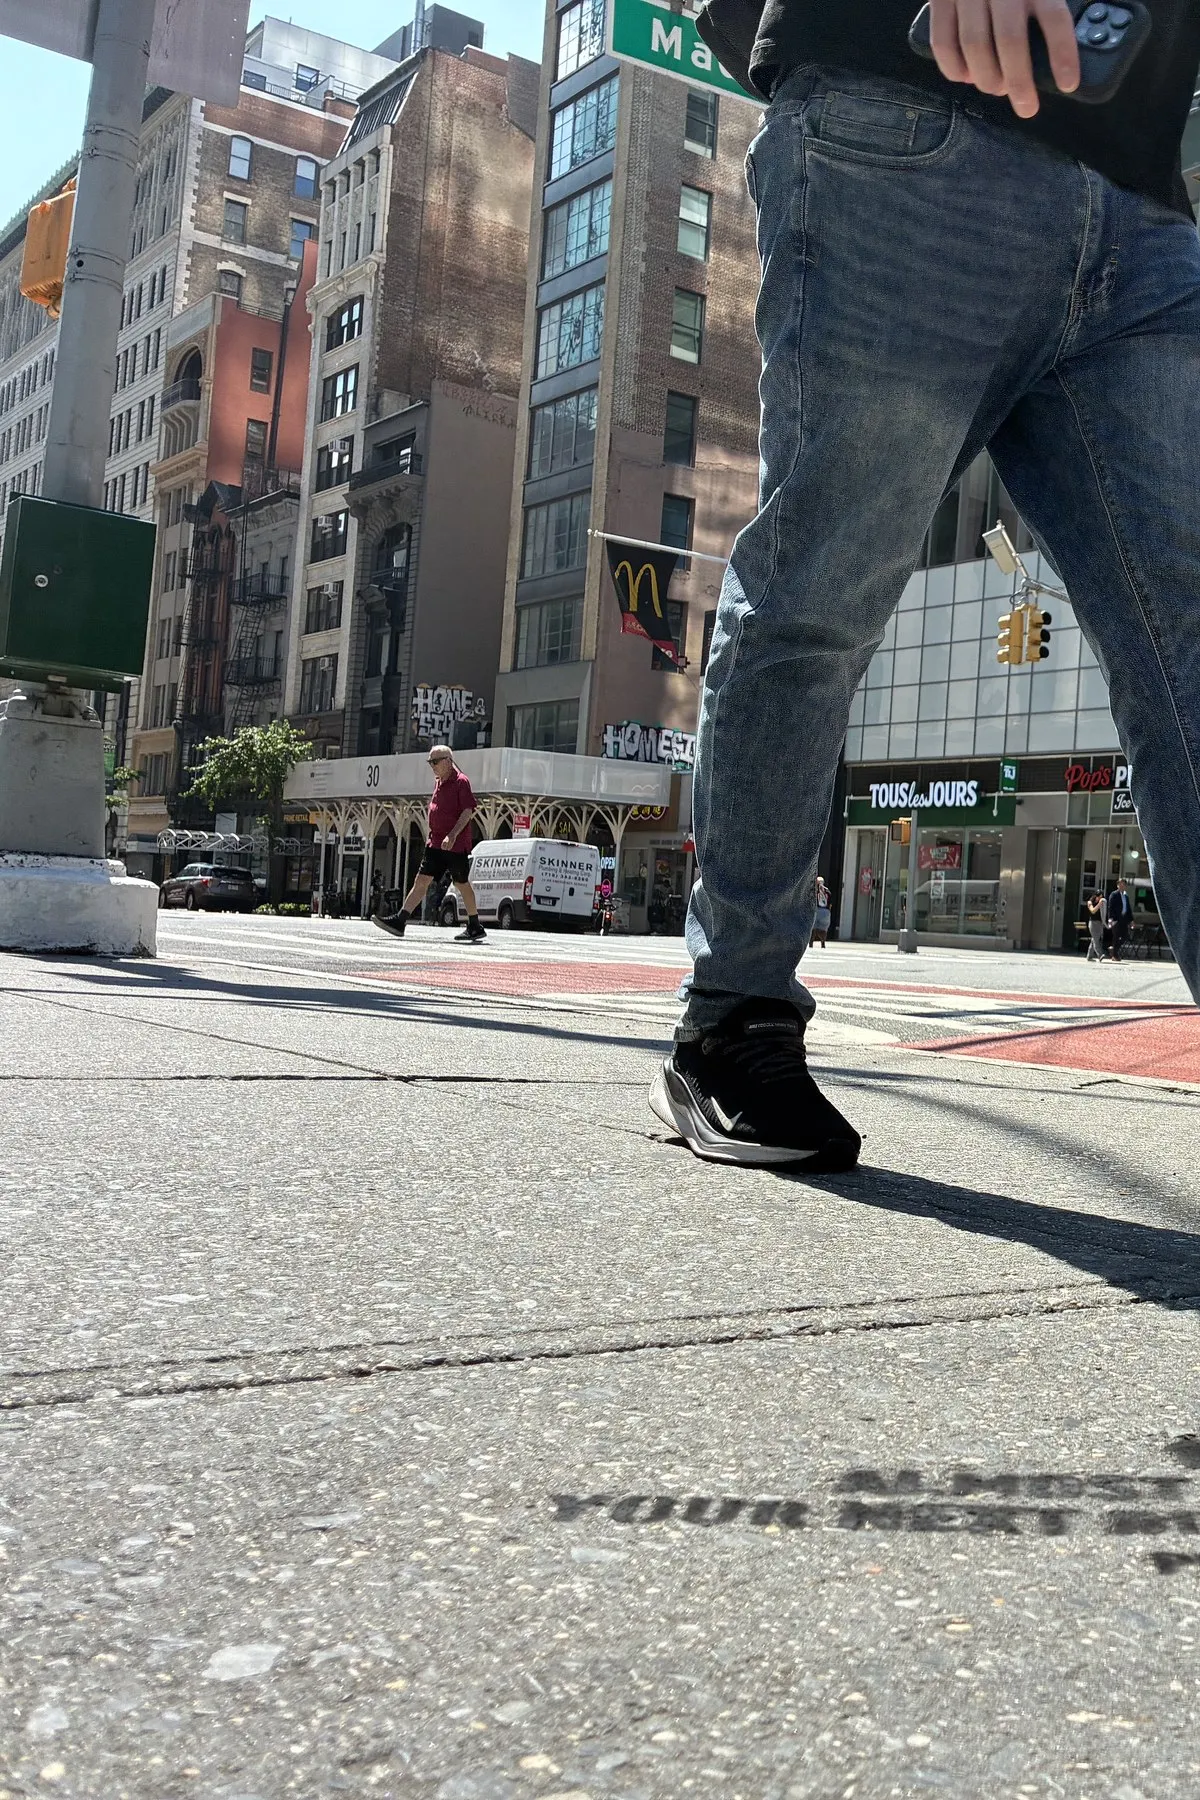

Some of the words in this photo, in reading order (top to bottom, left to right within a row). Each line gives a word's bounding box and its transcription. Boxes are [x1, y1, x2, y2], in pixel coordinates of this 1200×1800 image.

[651, 17, 733, 79] Ma
[366, 764, 380, 788] 30
[1064, 763, 1112, 793] Pop's
[869, 782, 909, 809] TOUS
[923, 779, 979, 808] JOURS
[476, 857, 525, 868] SKINNER
[539, 856, 593, 872] SKINNER
[601, 856, 616, 869] OPEN
[835, 1469, 1197, 1502] ALMOST
[546, 1493, 815, 1528] YOUR
[836, 1501, 1085, 1536] NEXT
